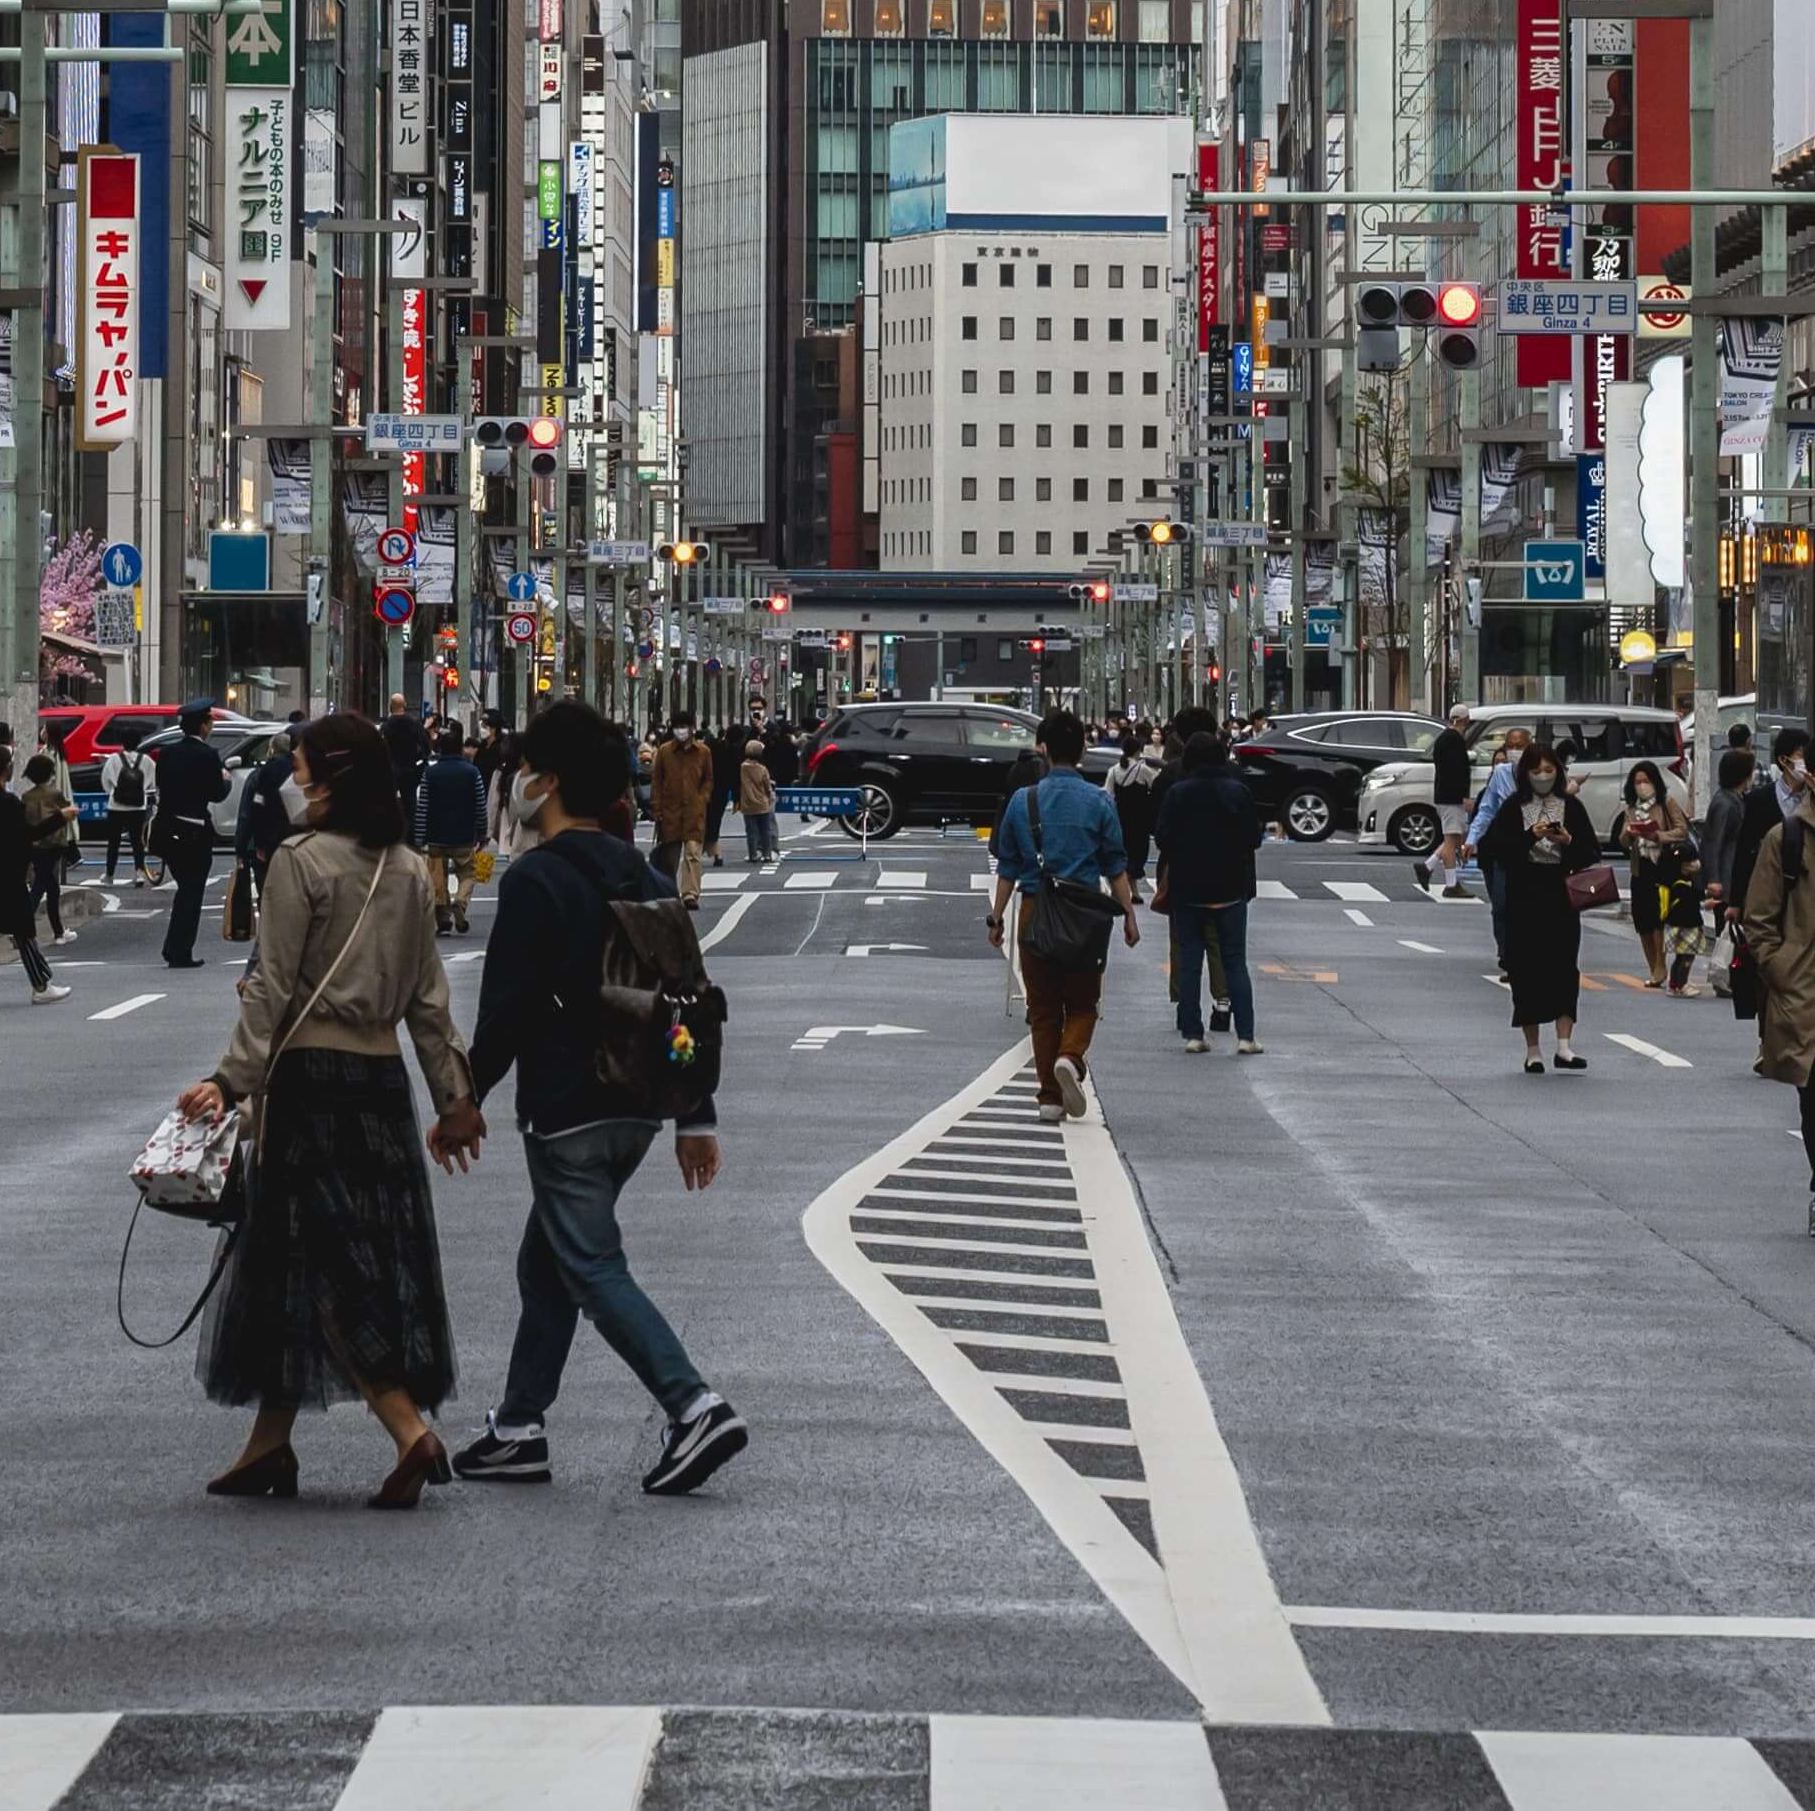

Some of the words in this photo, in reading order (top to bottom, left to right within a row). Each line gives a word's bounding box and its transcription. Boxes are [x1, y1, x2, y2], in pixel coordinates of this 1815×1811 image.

[398, 0, 421, 146] 日本香堂ビル
[270, 100, 284, 225] 子どもの本のみせ
[238, 107, 269, 260] ナルニア国
[271, 234, 283, 262] 9F
[1202, 226, 1216, 322] 銀座アスター
[1506, 282, 1544, 293] 中央区
[1507, 294, 1628, 316] 銀座四丁目
[1543, 317, 1577, 329] Ginza
[1583, 317, 1591, 329] 4
[373, 423, 458, 439] 銀座四丁目
[398, 439, 422, 448] Ginza
[425, 439, 431, 448] 4
[1586, 499, 1600, 557] ROYAL
[514, 621, 530, 634] 50
